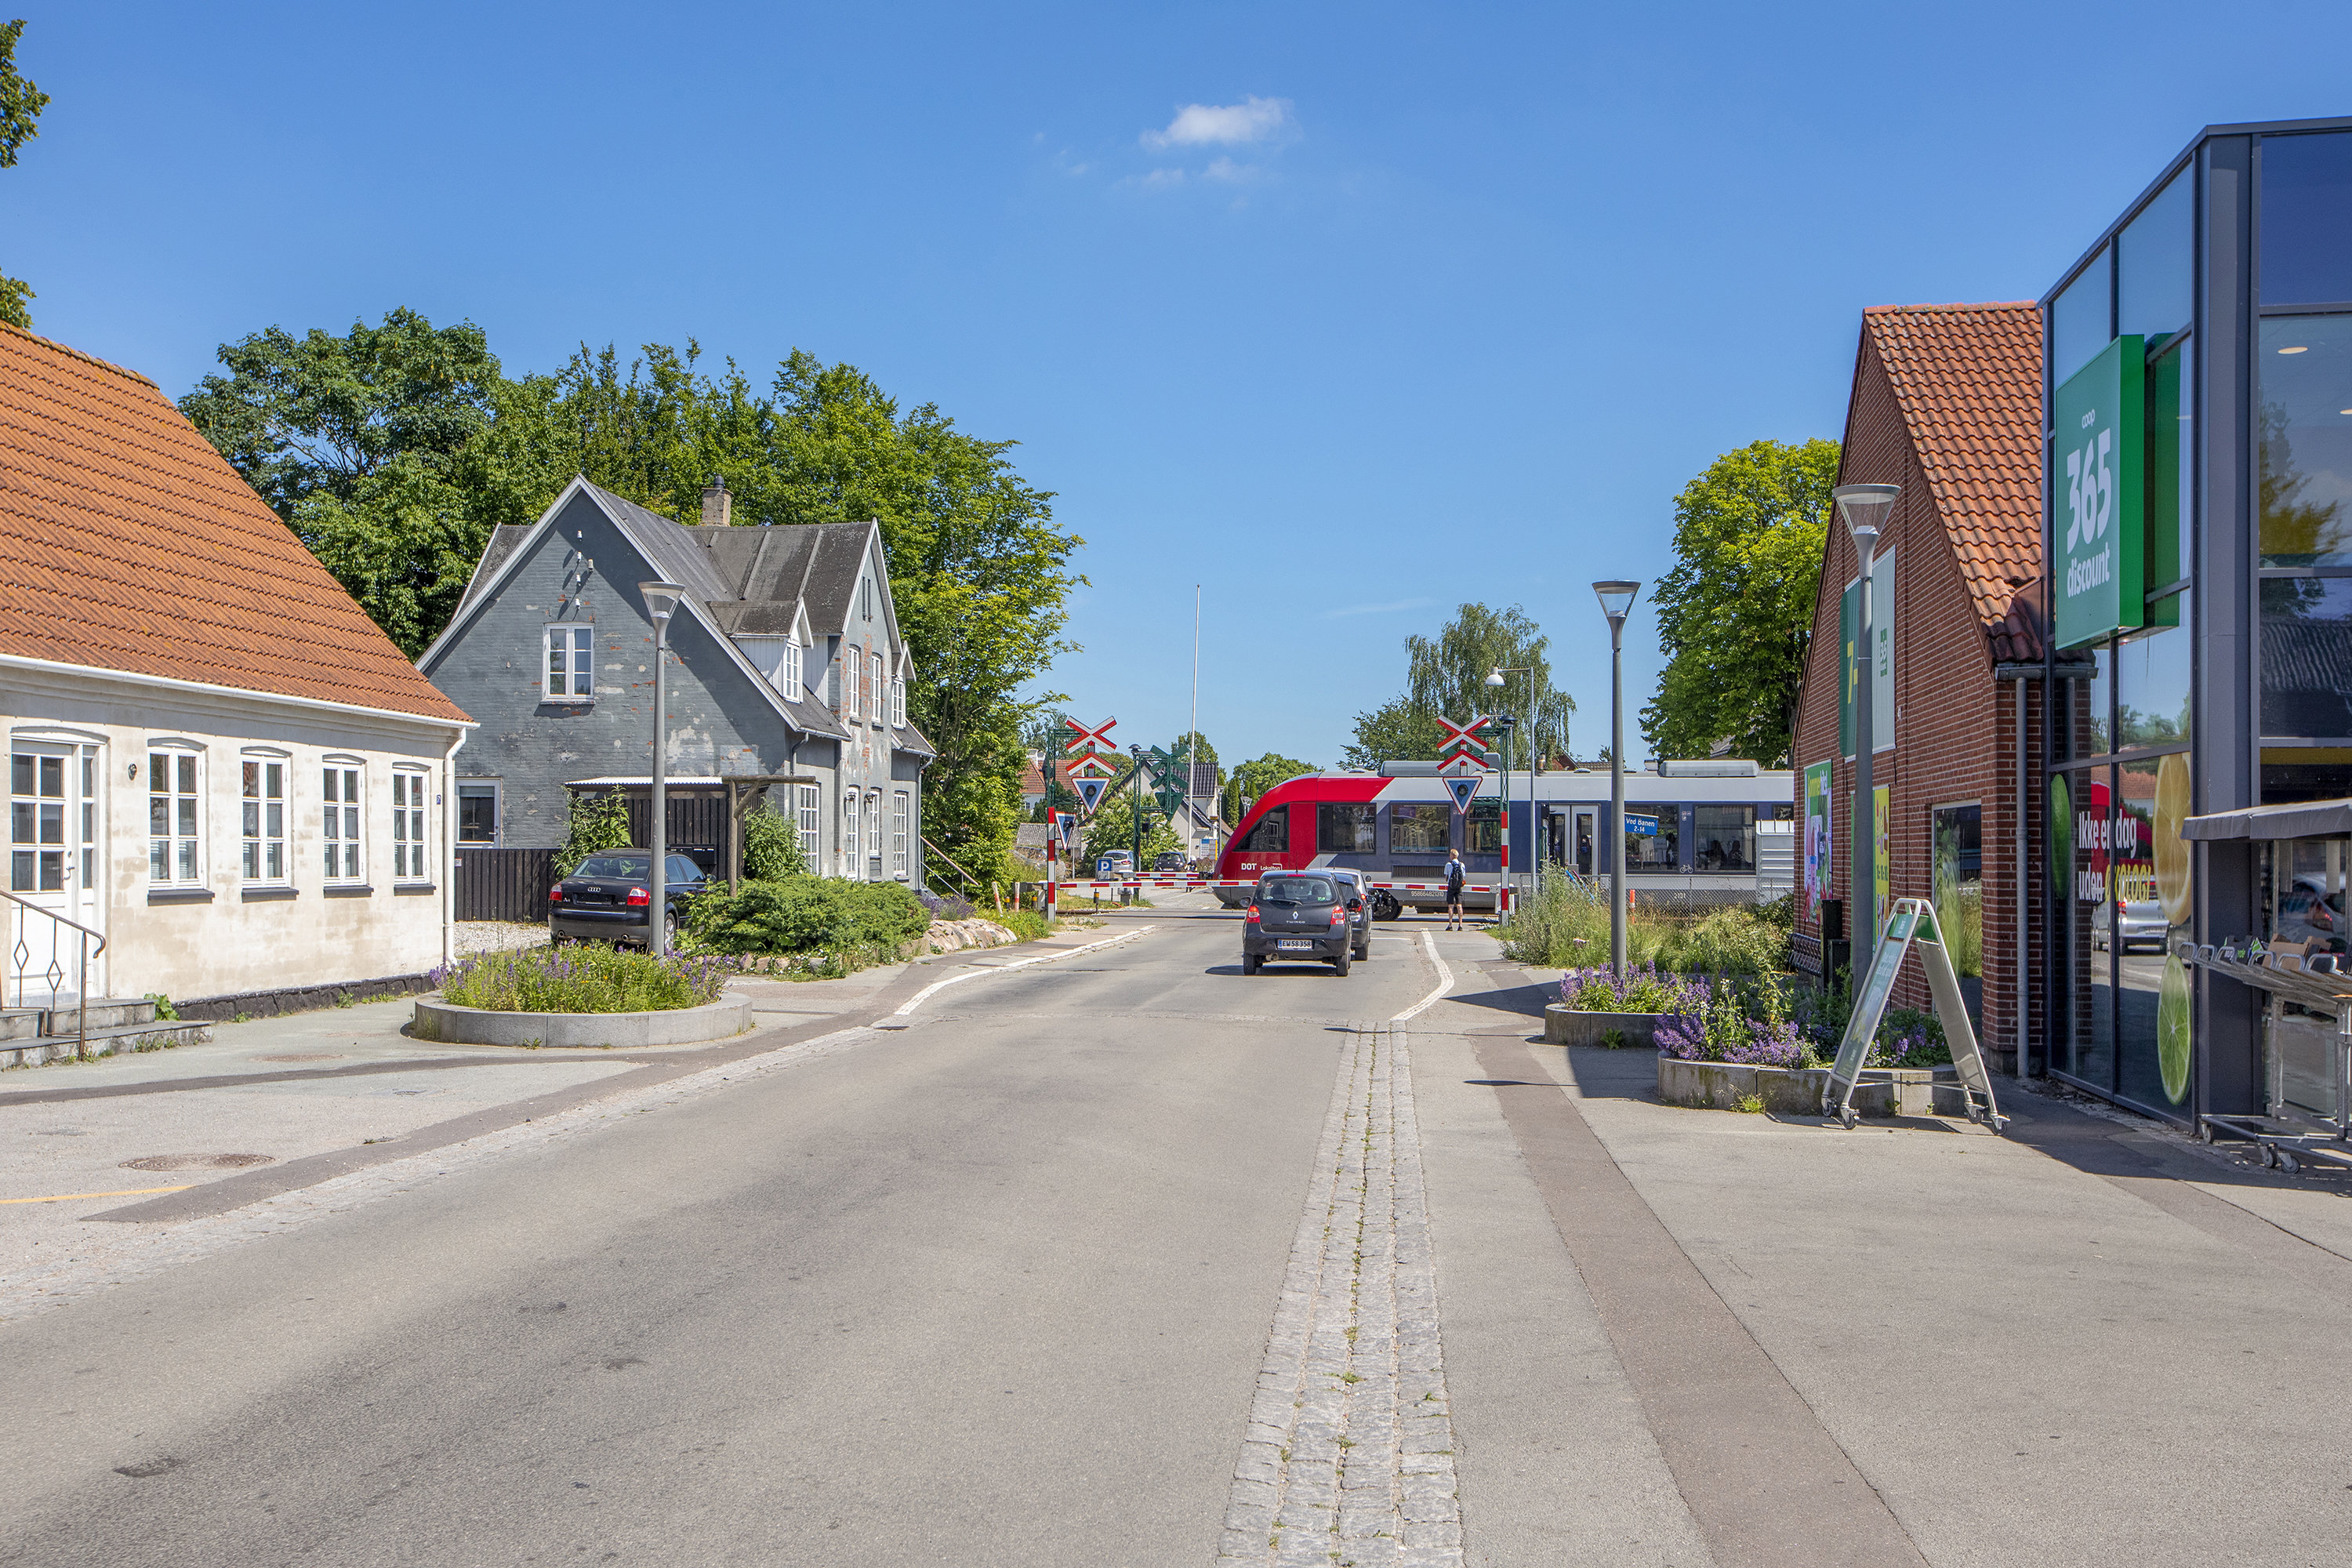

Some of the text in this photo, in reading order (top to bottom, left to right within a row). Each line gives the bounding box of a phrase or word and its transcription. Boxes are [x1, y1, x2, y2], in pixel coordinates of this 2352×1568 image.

[2082, 408, 2096, 429] coop
[2067, 427, 2111, 554] 365
[2067, 542, 2110, 598] discount
[1625, 816, 1655, 827] Ved Banen
[2078, 811, 2099, 849] Ikke
[2116, 808, 2136, 858] dag
[1101, 860, 1109, 871] P
[2078, 862, 2103, 902] uden
